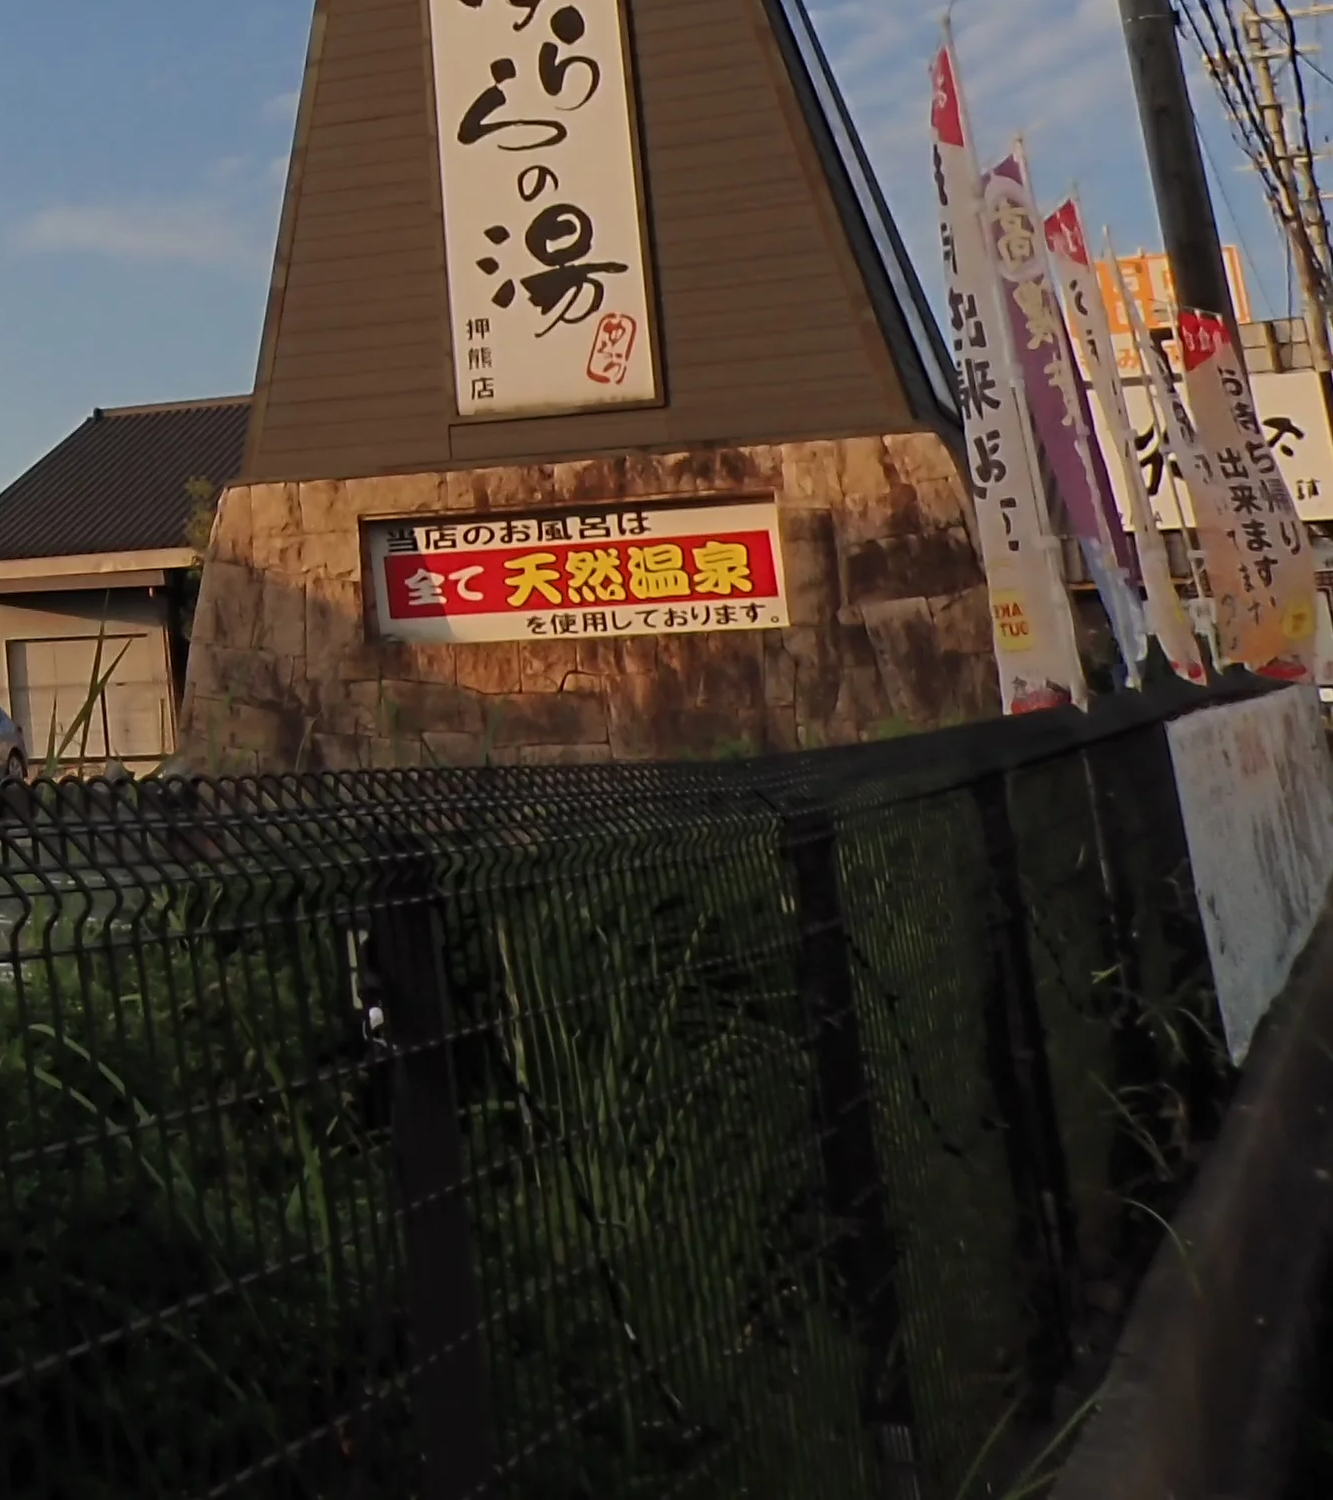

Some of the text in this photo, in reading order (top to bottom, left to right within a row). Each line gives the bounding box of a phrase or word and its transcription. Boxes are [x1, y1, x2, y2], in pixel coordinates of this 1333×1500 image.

[466, 316, 494, 400] 押熊店
[386, 511, 651, 553] 当店のお風呂は
[404, 541, 754, 608] 全て 天然温泉
[526, 602, 780, 635] を使用しております。
